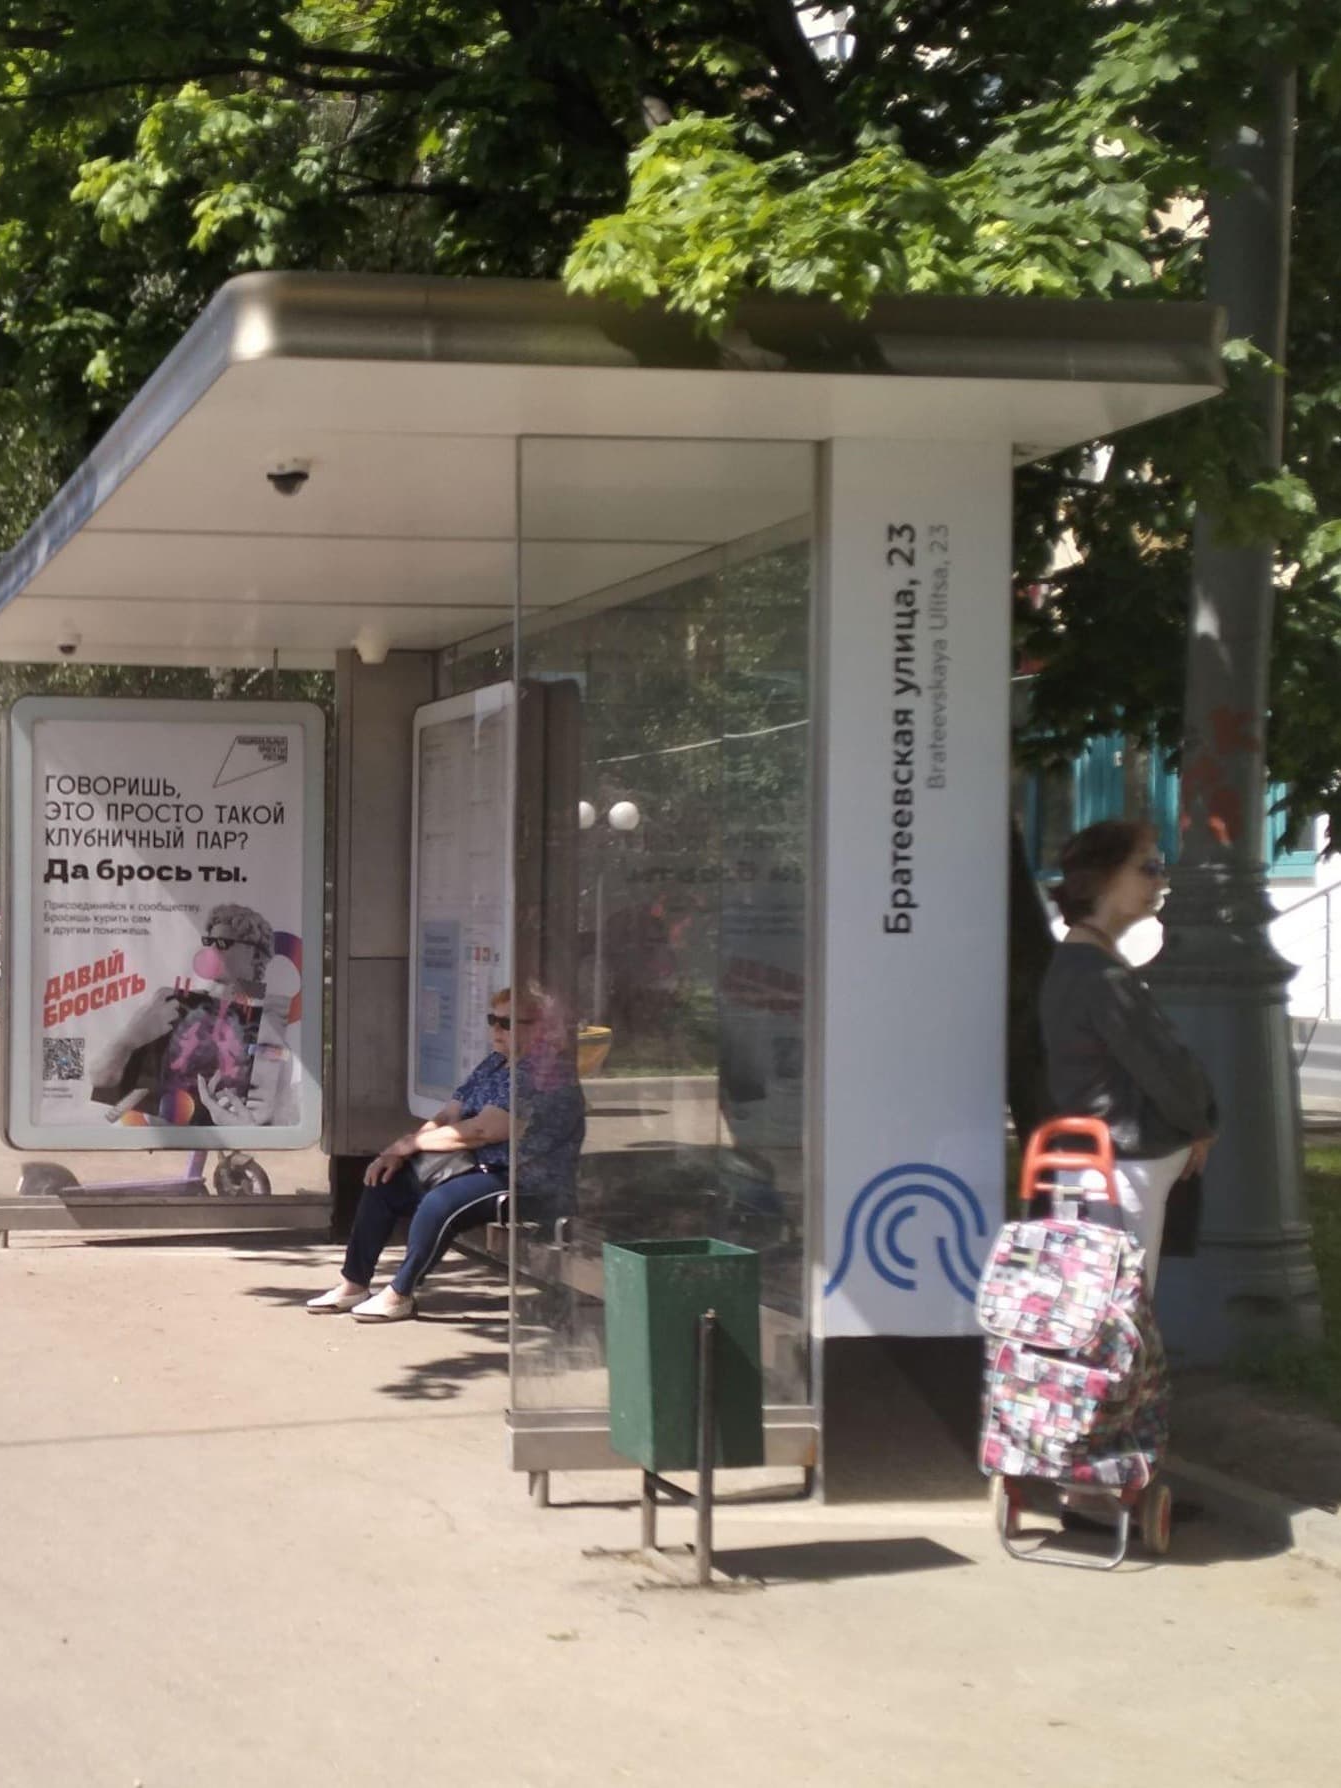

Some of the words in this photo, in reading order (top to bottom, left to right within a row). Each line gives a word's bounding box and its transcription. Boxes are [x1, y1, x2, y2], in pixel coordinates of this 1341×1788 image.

[887, 523, 916, 567] 23
[929, 524, 948, 553] 23
[894, 579, 922, 697] улица,
[926, 639, 953, 789] Brateevskaya
[45, 775, 181, 799] ГОВОРИШЬ,
[44, 801, 95, 820] ЭТО
[107, 802, 203, 823] ПРОСТО
[216, 802, 285, 825] ТАКОЙ
[883, 708, 919, 934] Братеевская
[197, 831, 249, 850] ПАР?
[44, 859, 89, 883] Да
[97, 859, 193, 886] брось
[199, 866, 248, 883] ты.
[44, 900, 126, 911] Присоединяйся
[94, 914, 129, 925] курить
[52, 927, 90, 936] другим
[44, 949, 125, 1004] ДАВАЙ
[43, 973, 147, 1028] БРОСАТЬ
